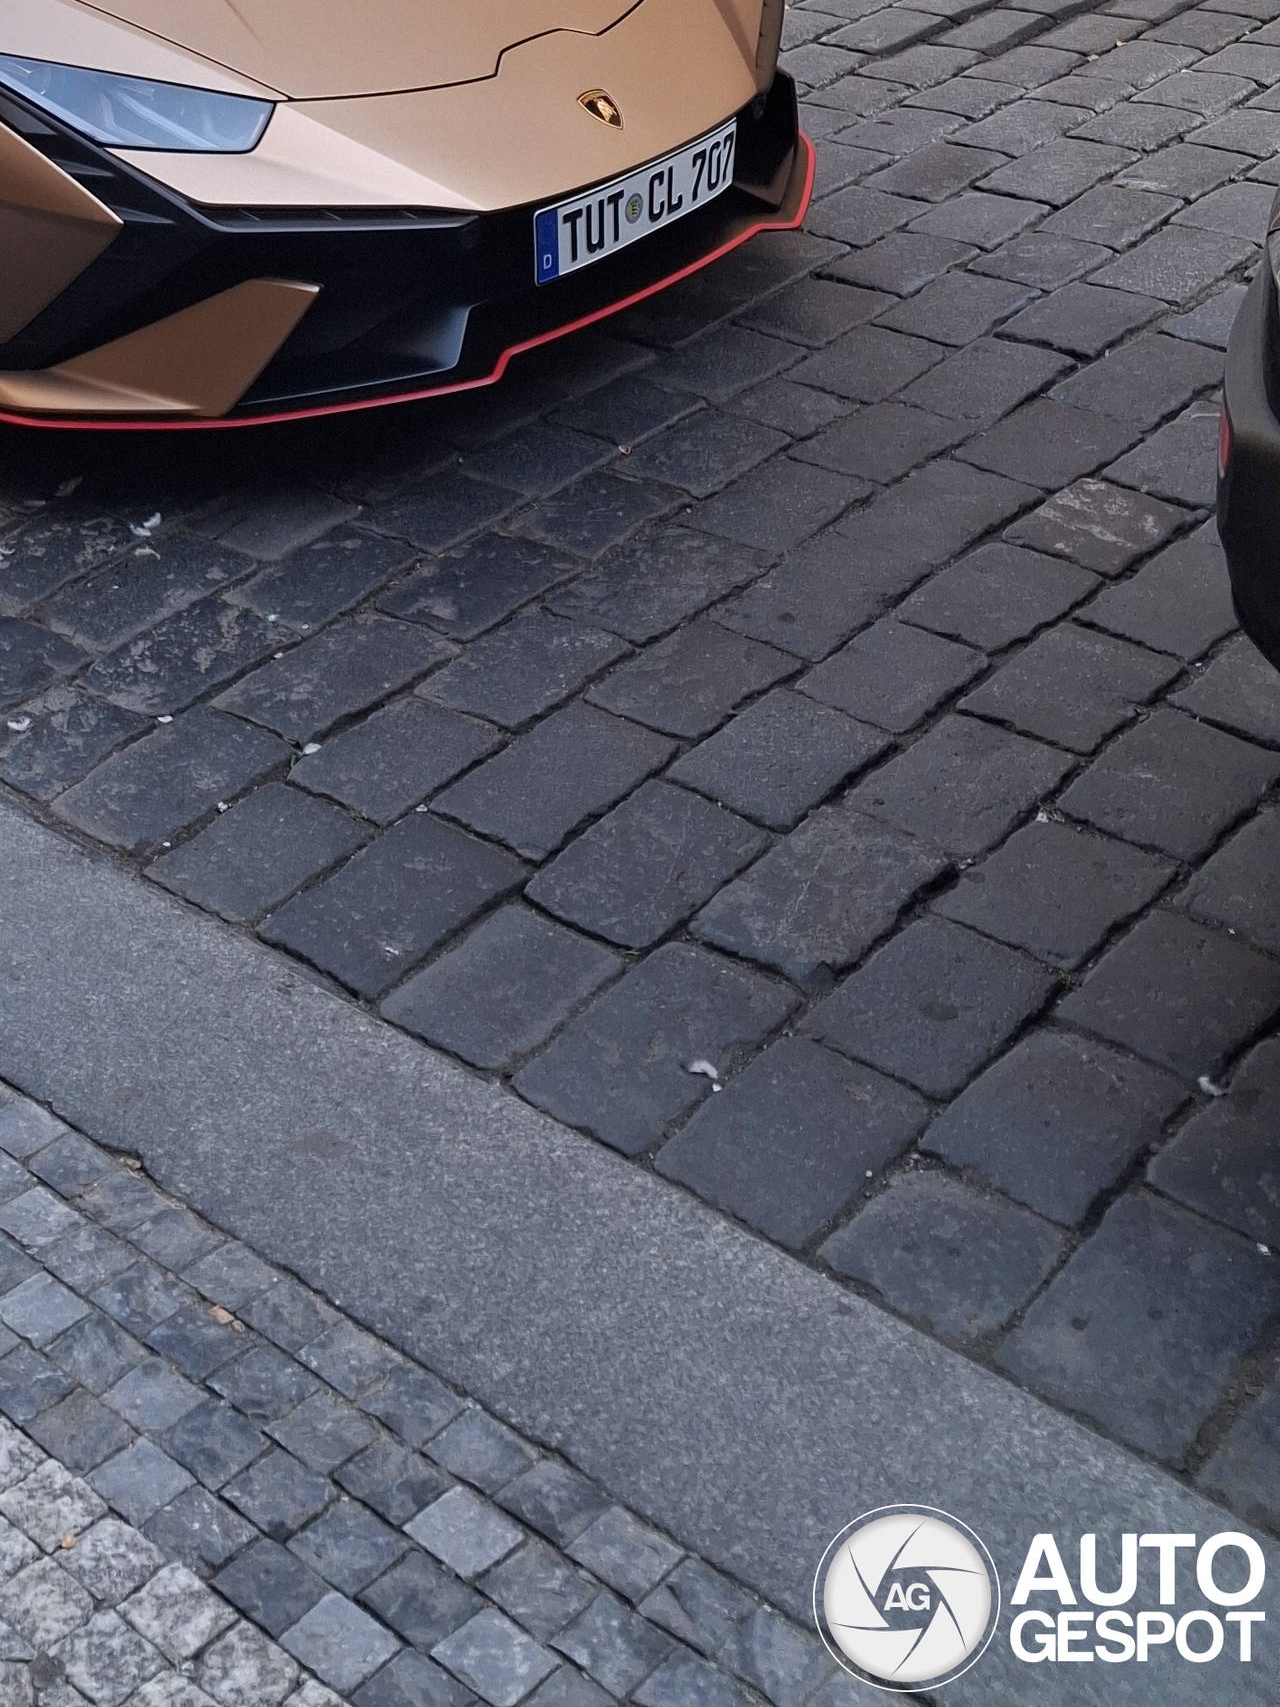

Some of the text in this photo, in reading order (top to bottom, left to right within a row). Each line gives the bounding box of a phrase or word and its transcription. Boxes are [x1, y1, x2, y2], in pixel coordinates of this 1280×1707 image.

[563, 130, 735, 263] TUT CL 707
[543, 254, 552, 270] D
